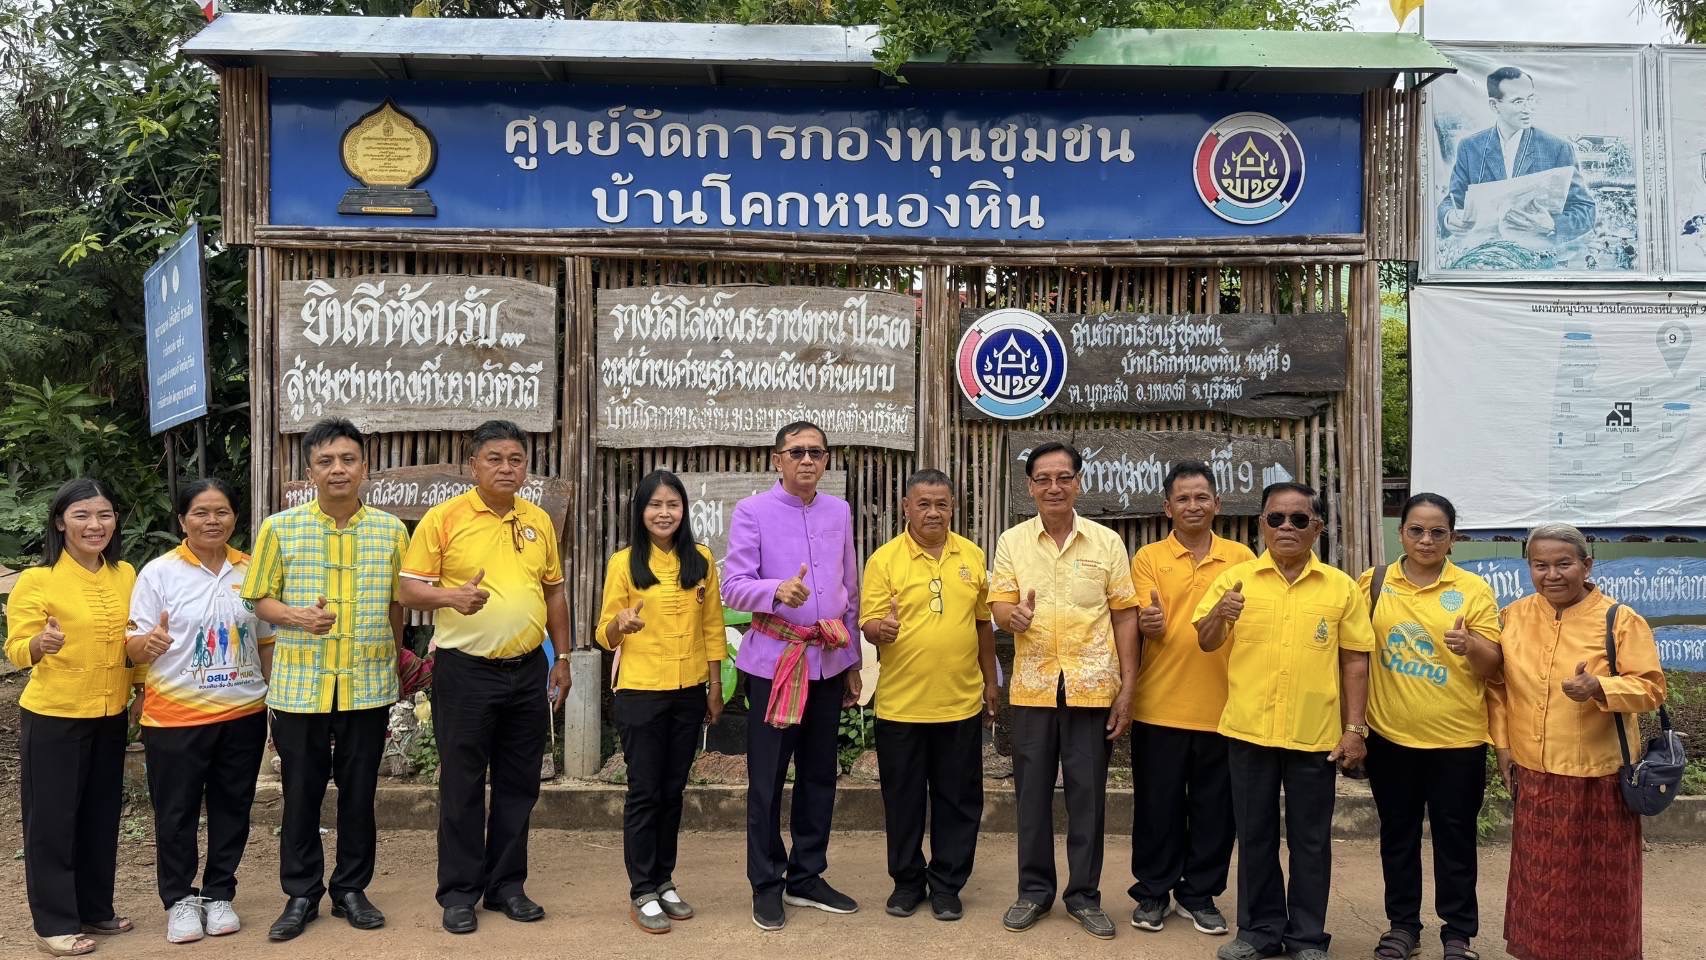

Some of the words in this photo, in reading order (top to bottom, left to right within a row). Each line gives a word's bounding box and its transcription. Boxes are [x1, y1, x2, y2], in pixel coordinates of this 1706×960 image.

[504, 105, 1135, 178] ศูนย์จัดการกองทุนชุมชน
[592, 172, 1046, 230] บ้านโคกหนองหิน
[1531, 299, 1593, 317] แผนที่หมู่บ้าน
[1676, 299, 1699, 318] หมู่ที่
[1070, 312, 1224, 357] ศูนย์การเรียนรู้ชุมชน
[1669, 333, 1677, 344] 9
[1121, 349, 1242, 375] บ้านโคกหนองหิน
[1281, 354, 1291, 372] 9
[1238, 461, 1254, 493] 9
[1381, 648, 1448, 686] Chang
